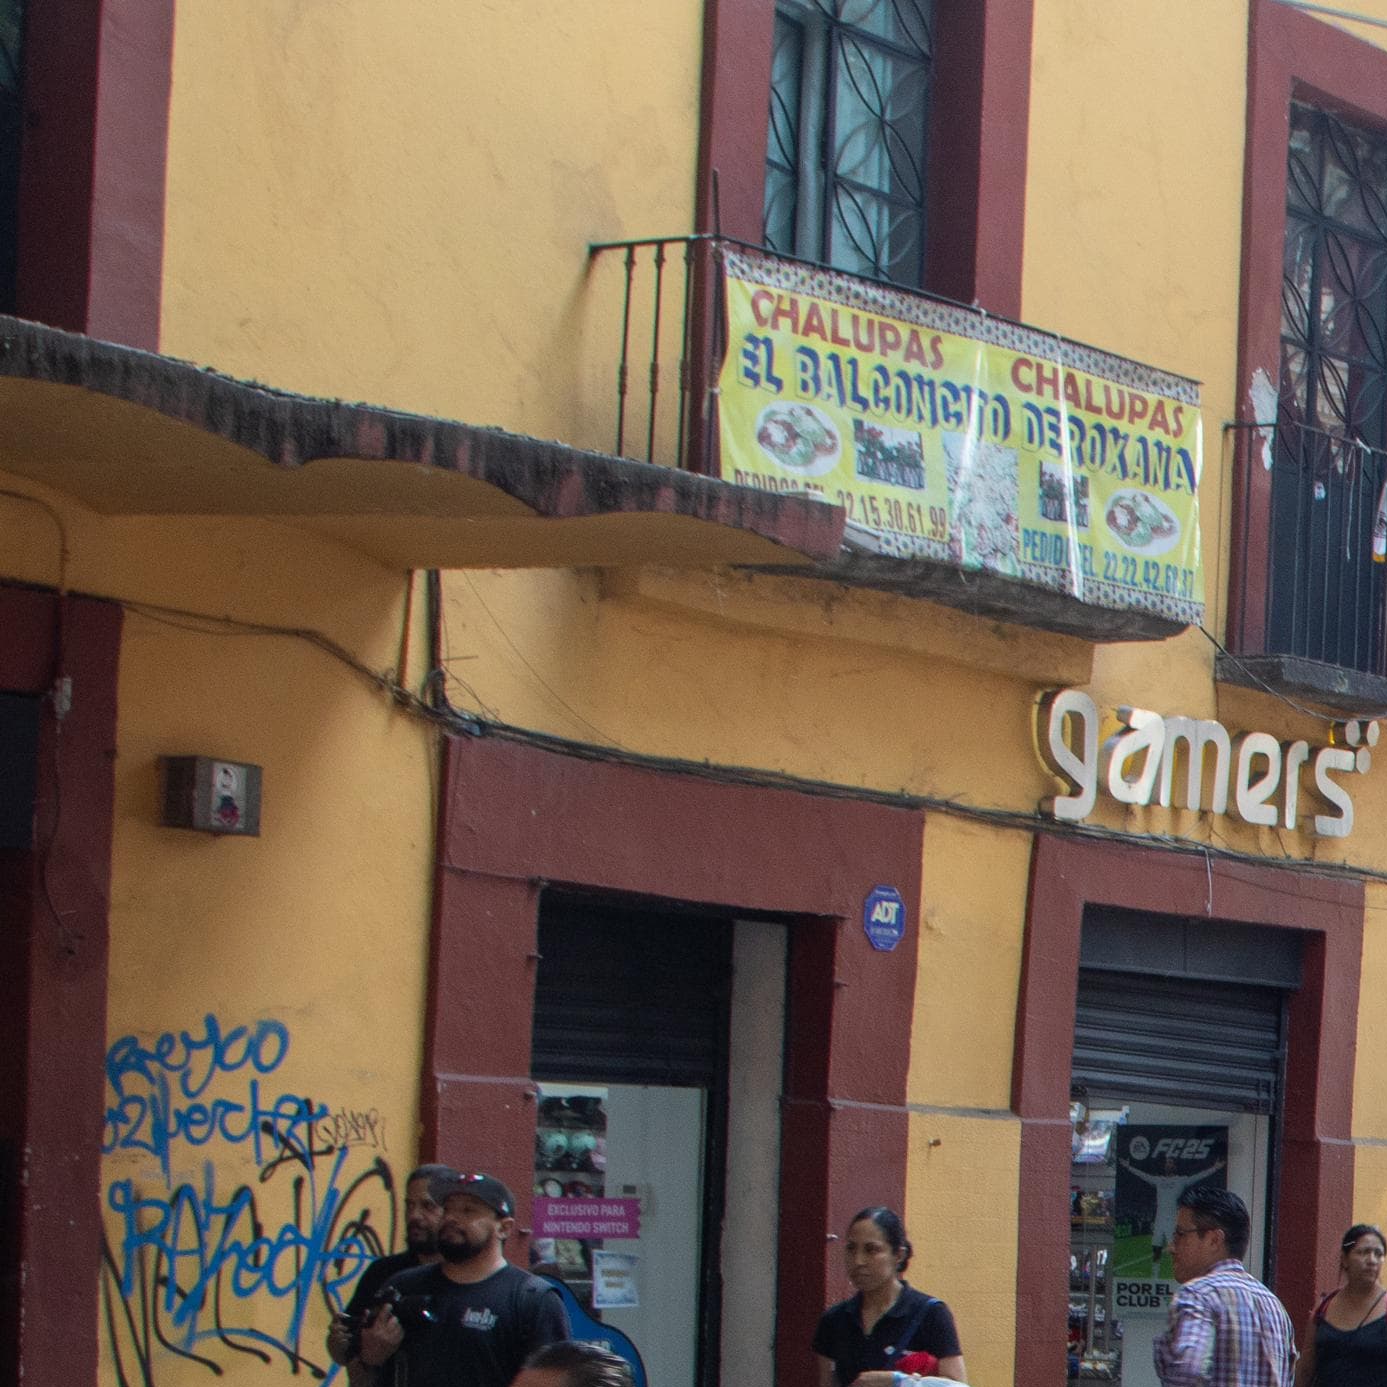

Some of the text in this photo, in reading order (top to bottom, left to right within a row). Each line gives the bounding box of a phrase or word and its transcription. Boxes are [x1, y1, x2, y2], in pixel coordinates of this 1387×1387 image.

[751, 289, 945, 371] CHALUPAS
[739, 332, 784, 395] EL
[794, 345, 1012, 443] BALCONCITO
[1011, 358, 1184, 438] CHALUPAS
[1047, 688, 1357, 839] gamers
[871, 900, 900, 925] ADT
[547, 1204, 626, 1216] EXCLUSIVO PARA
[543, 1222, 629, 1234] NINTENDO SWITCH
[1115, 1295, 1161, 1309] CLUB
[1116, 1282, 1174, 1297] POR EL
